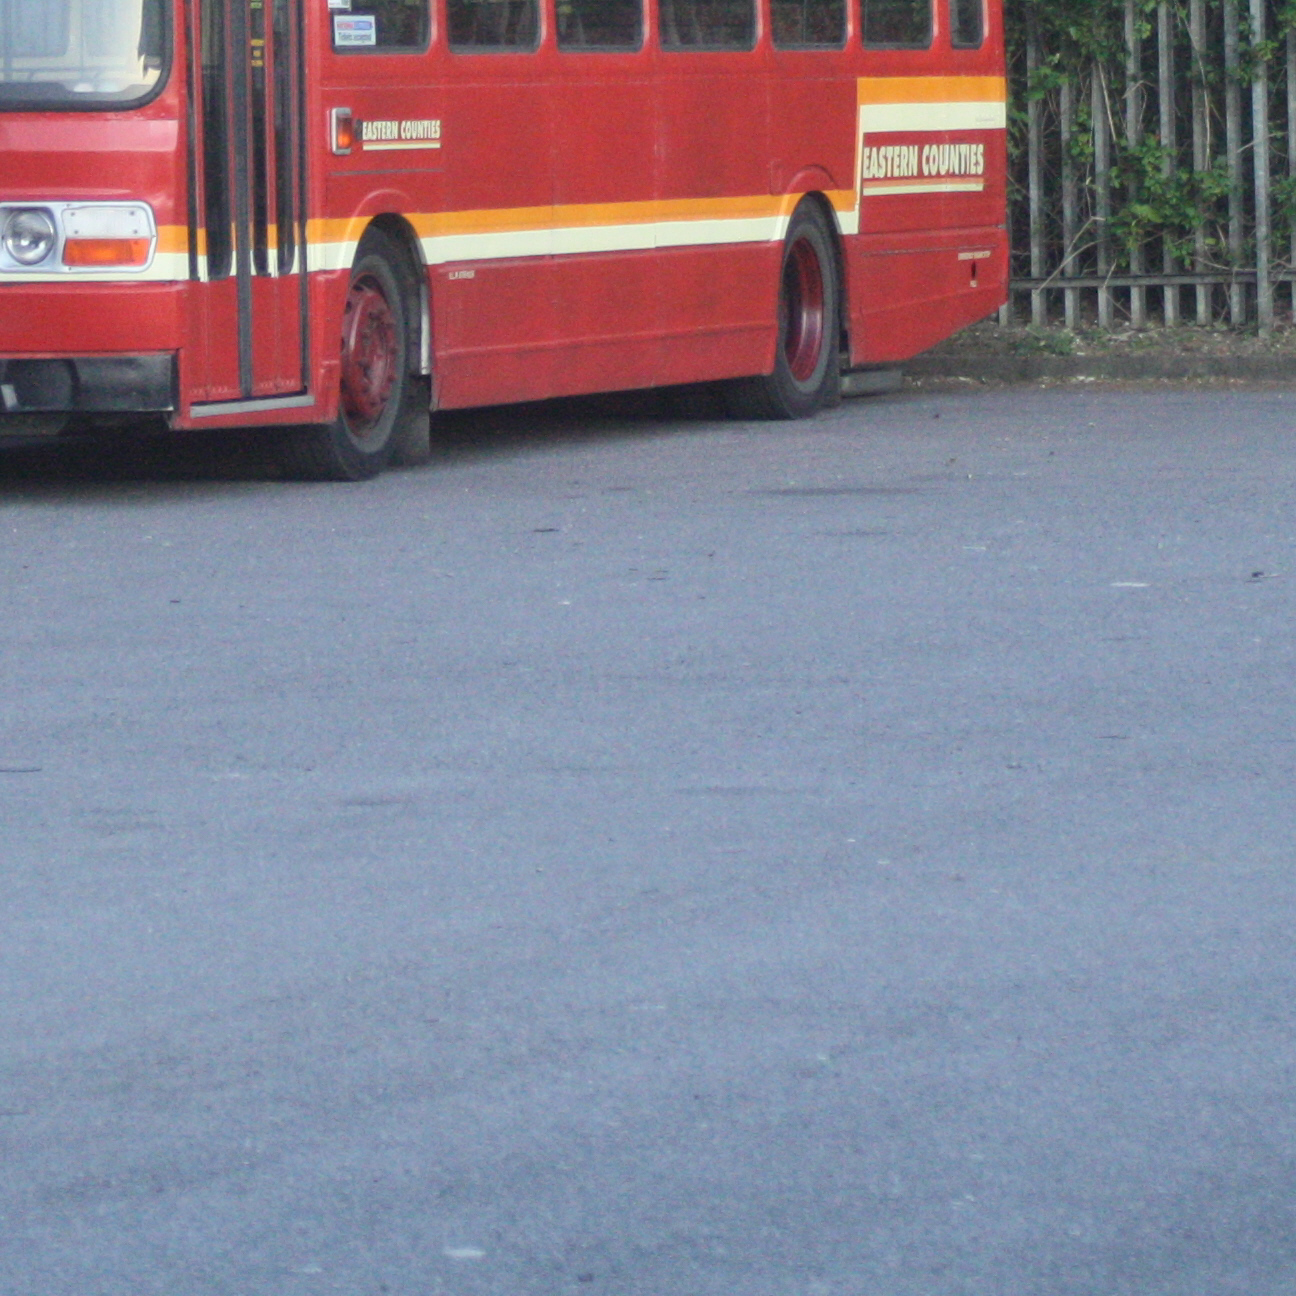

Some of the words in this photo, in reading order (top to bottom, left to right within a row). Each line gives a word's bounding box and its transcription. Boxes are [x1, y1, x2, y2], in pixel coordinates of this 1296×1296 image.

[363, 120, 399, 140] EASTERN
[400, 119, 441, 139] COUNTIES
[863, 146, 918, 178] EASTERN
[922, 143, 984, 176] COUNTIES
